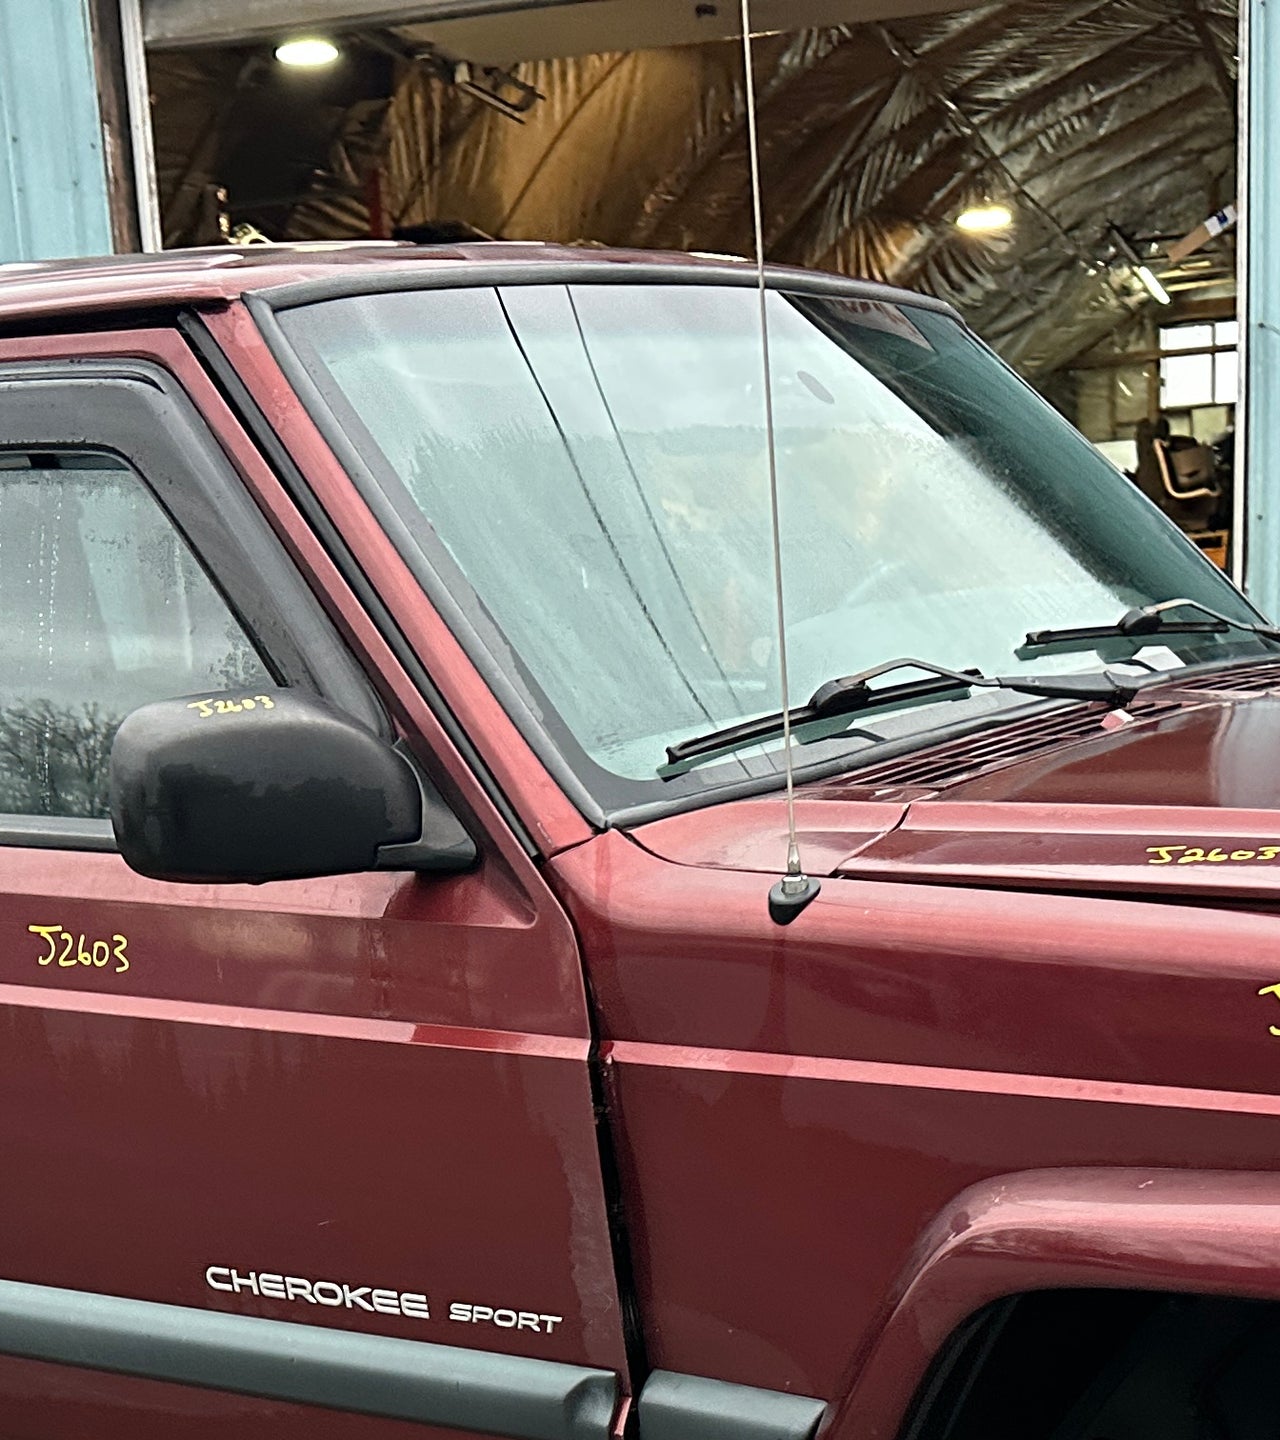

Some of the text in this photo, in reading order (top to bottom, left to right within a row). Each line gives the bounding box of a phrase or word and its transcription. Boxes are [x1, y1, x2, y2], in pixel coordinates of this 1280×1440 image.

[187, 695, 275, 718] J2603
[28, 924, 130, 973] J2603
[205, 1266, 563, 1334] CHEROKEE SPORT
